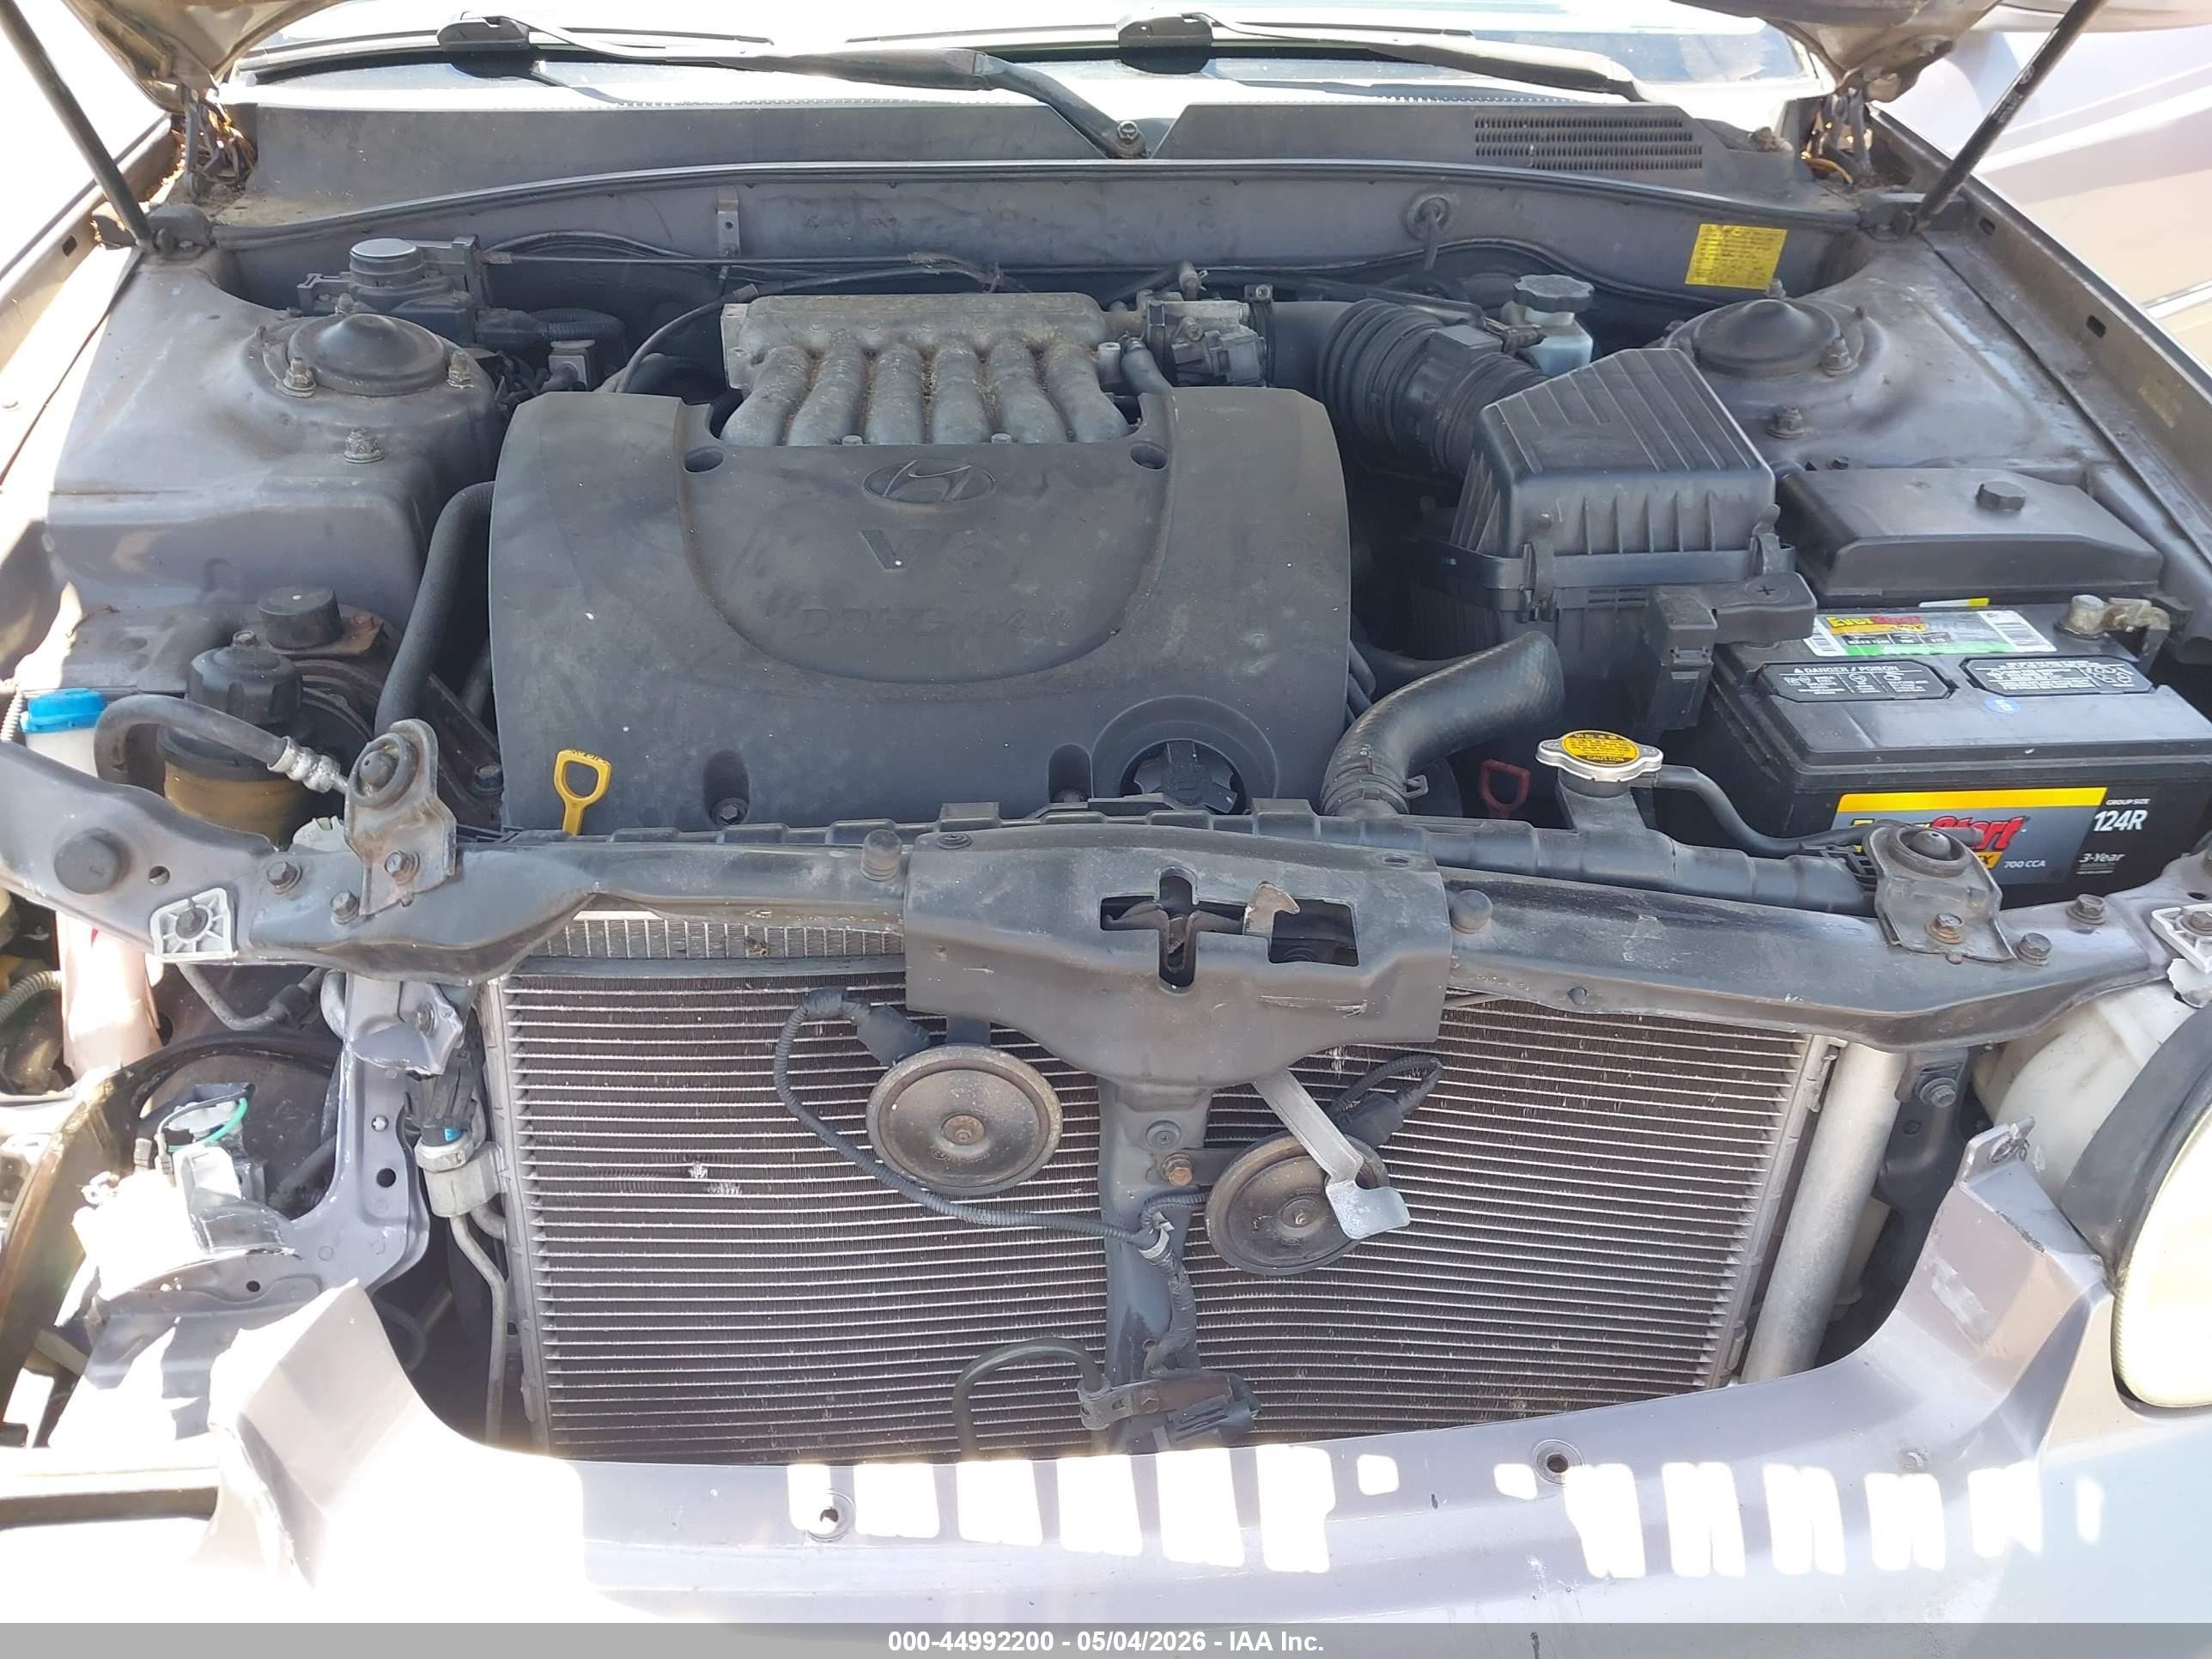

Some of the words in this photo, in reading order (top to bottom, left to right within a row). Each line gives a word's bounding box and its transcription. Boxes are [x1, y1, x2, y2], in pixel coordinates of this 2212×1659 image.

[2094, 809, 2148, 832] 124R
[2078, 852, 2126, 864] 3-Year
[2004, 860, 2024, 869] 700
[2025, 860, 2046, 868] CCA
